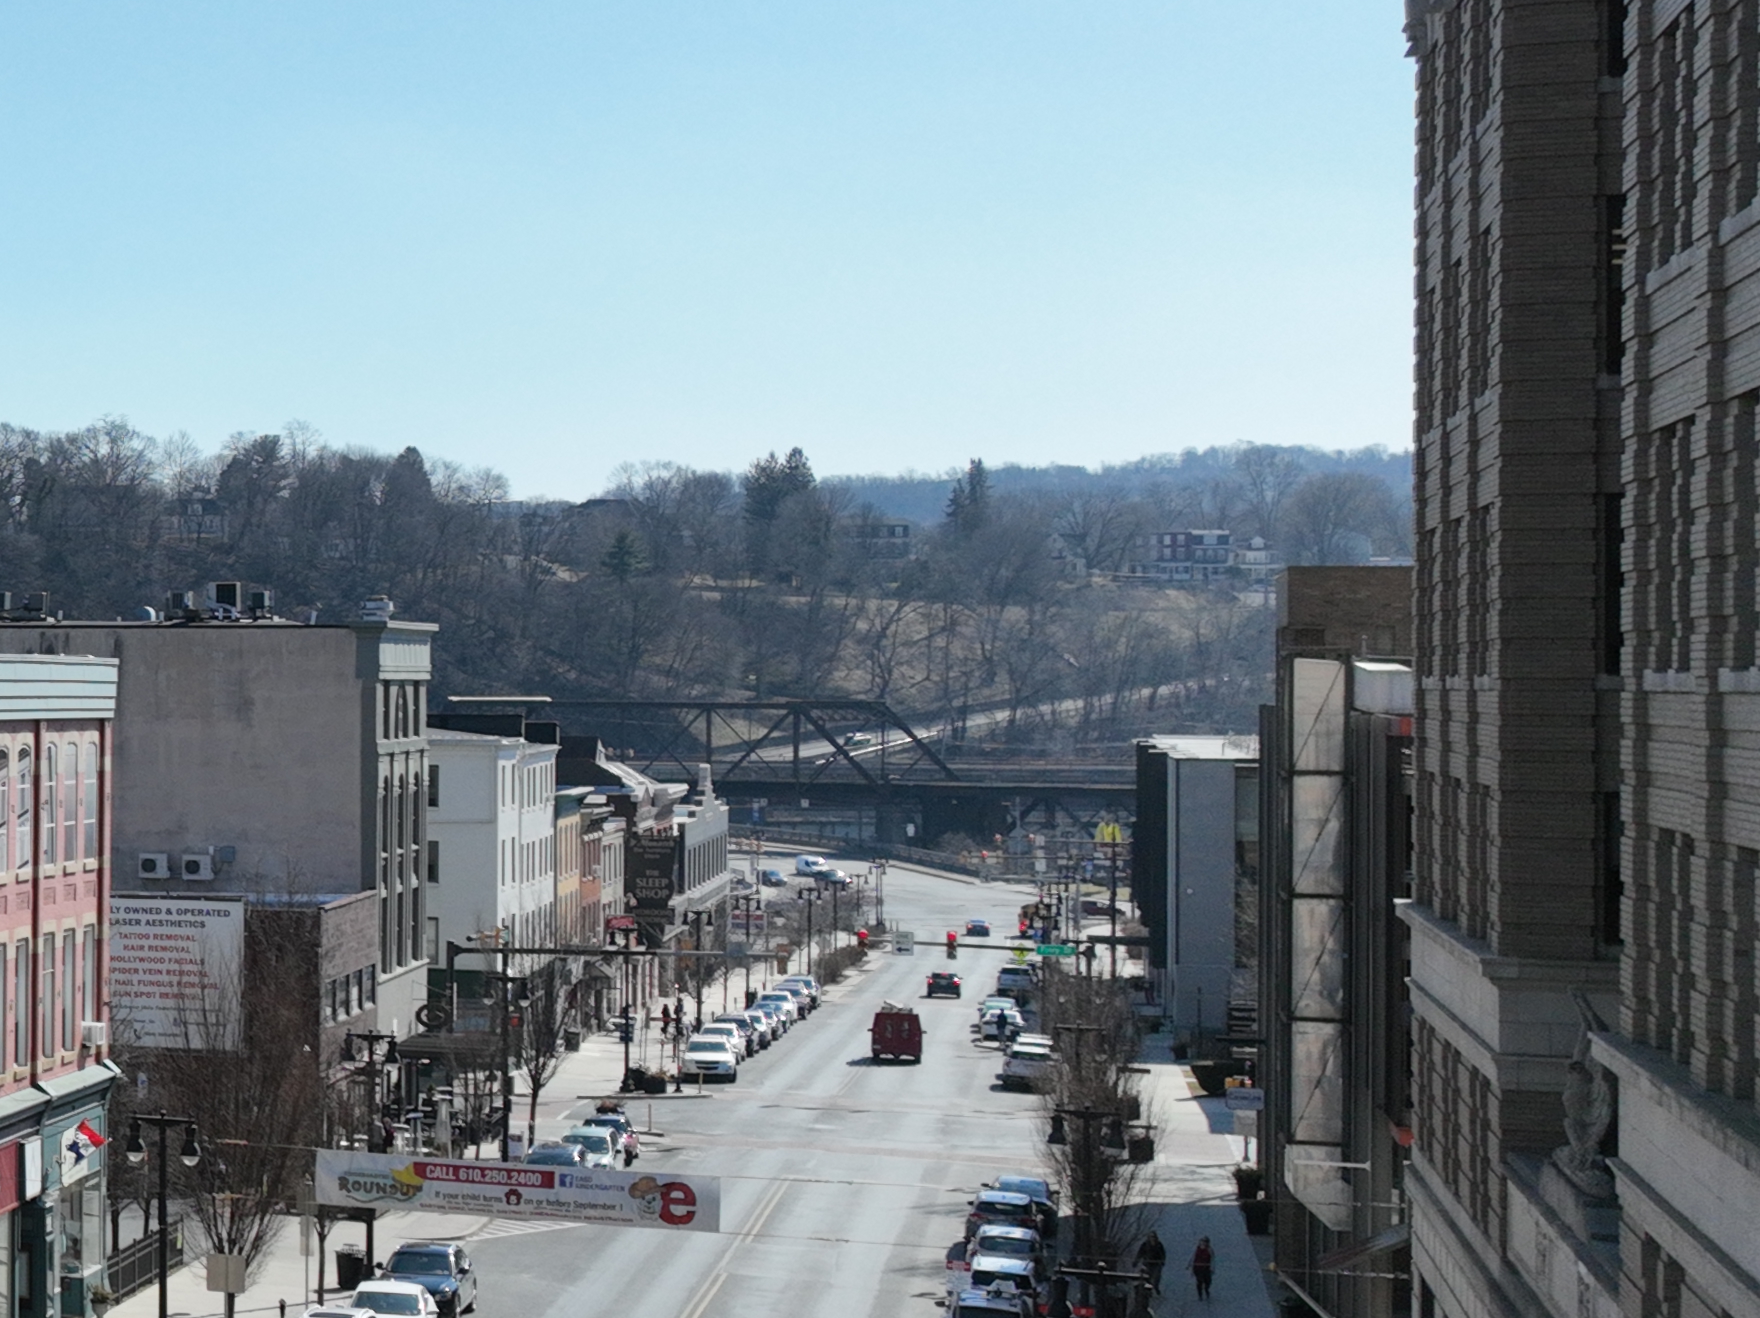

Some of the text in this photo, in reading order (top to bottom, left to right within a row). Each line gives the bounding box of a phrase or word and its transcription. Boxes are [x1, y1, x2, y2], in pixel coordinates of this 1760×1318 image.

[636, 877, 669, 887] SLEEP
[636, 888, 670, 898] SHOP
[123, 906, 162, 916] OWNED
[165, 907, 173, 916] &
[176, 908, 230, 917] OPERATED
[145, 919, 206, 928] AESTHETICS
[118, 932, 197, 942] TATTOO REMOVAL
[123, 944, 191, 953] HAIR REMOVAL
[110, 955, 205, 966] HOLLYWOOD FACIALS
[142, 968, 163, 976] VEIN
[166, 969, 209, 977] REMOVAL
[137, 979, 174, 988] FUNGUS
[177, 981, 220, 990] REMOVAL
[133, 991, 157, 999] SPOT
[426, 1165, 542, 1186] CALL 610.250.2400
[442, 1192, 459, 1201] your
[461, 1192, 480, 1201] child
[483, 1194, 503, 1203] turns
[524, 1198, 534, 1206] on
[536, 1198, 544, 1207] or
[546, 1198, 572, 1209] before
[573, 1200, 617, 1211] September
